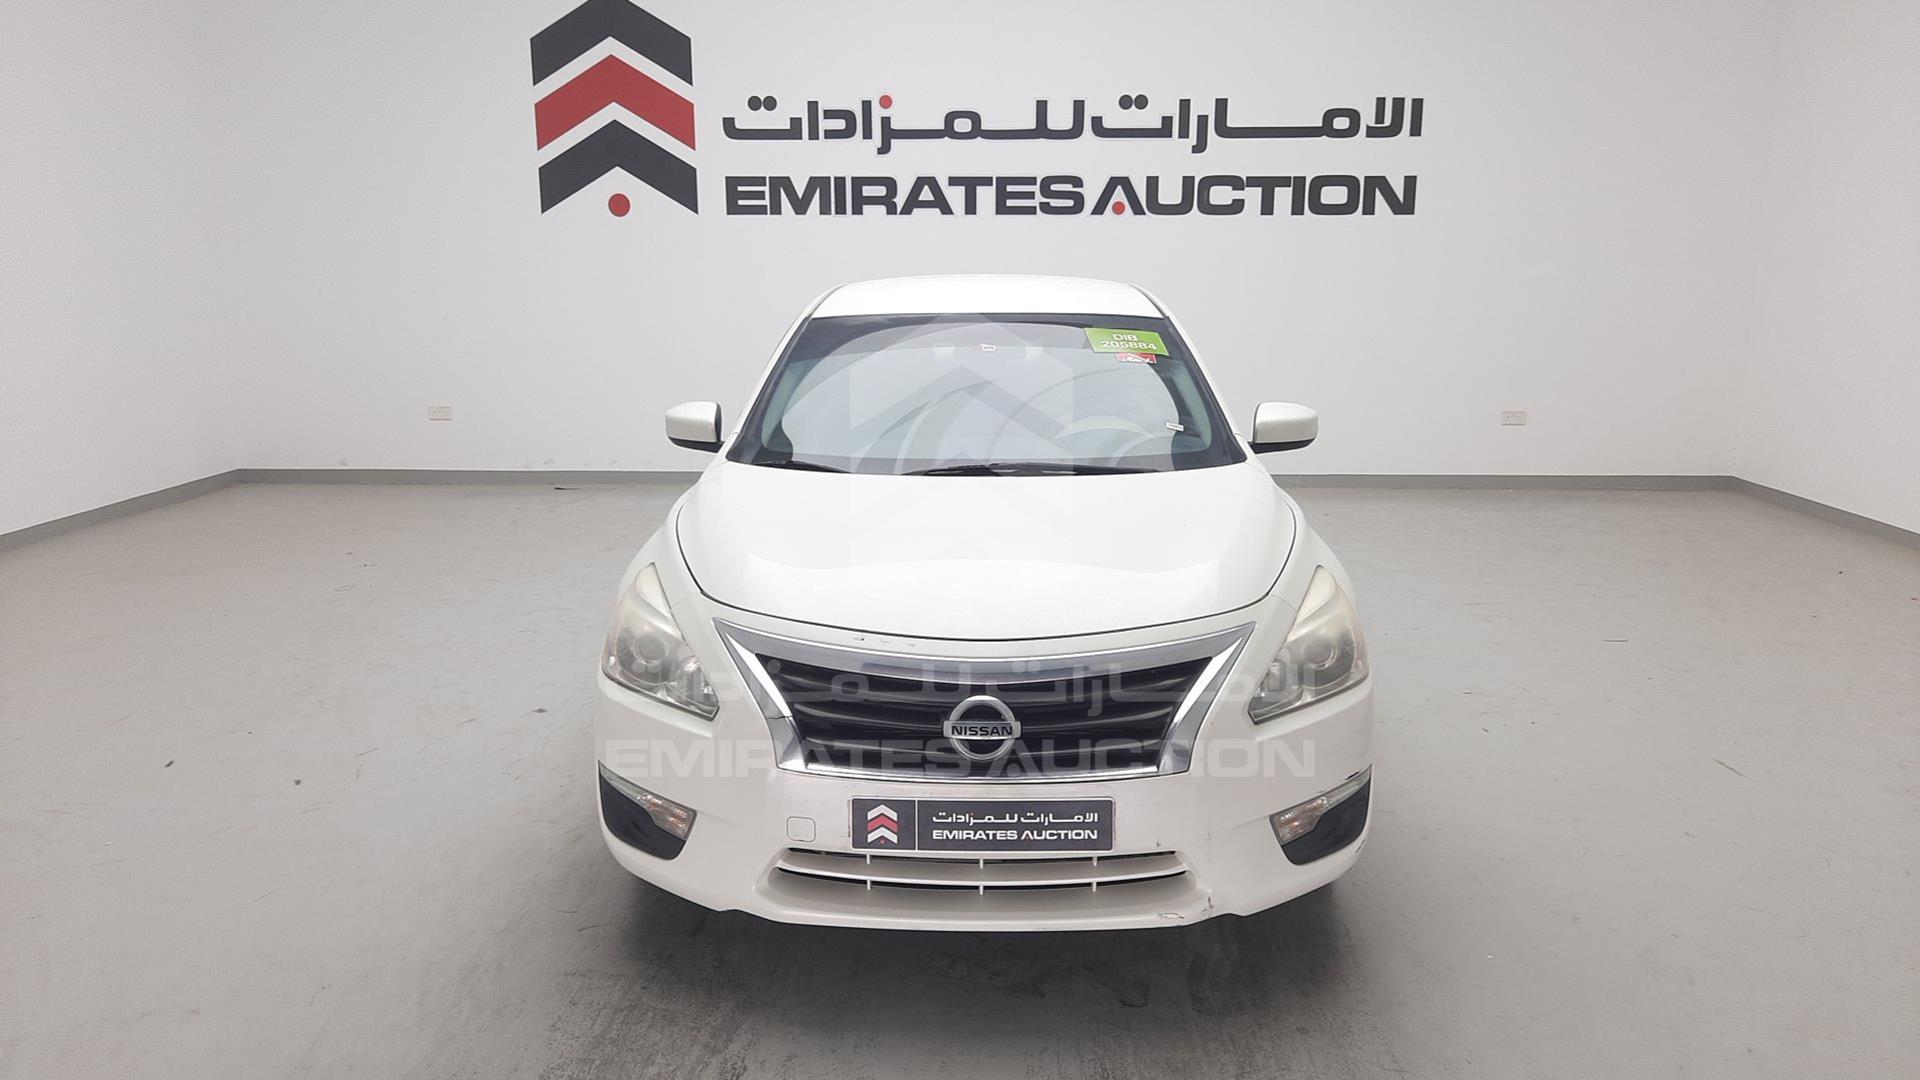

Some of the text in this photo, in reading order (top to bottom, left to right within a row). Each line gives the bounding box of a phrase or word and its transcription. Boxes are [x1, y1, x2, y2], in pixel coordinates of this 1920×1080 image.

[722, 94, 1424, 155] الامارات للمزادات
[725, 175, 1417, 216] EMIRATES AUCTION
[1112, 333, 1138, 341] DIB
[951, 725, 1013, 736] NISSAN
[932, 812, 1098, 826] الامارات للمزادات
[932, 830, 1098, 840] EMIRATES AUCTION
